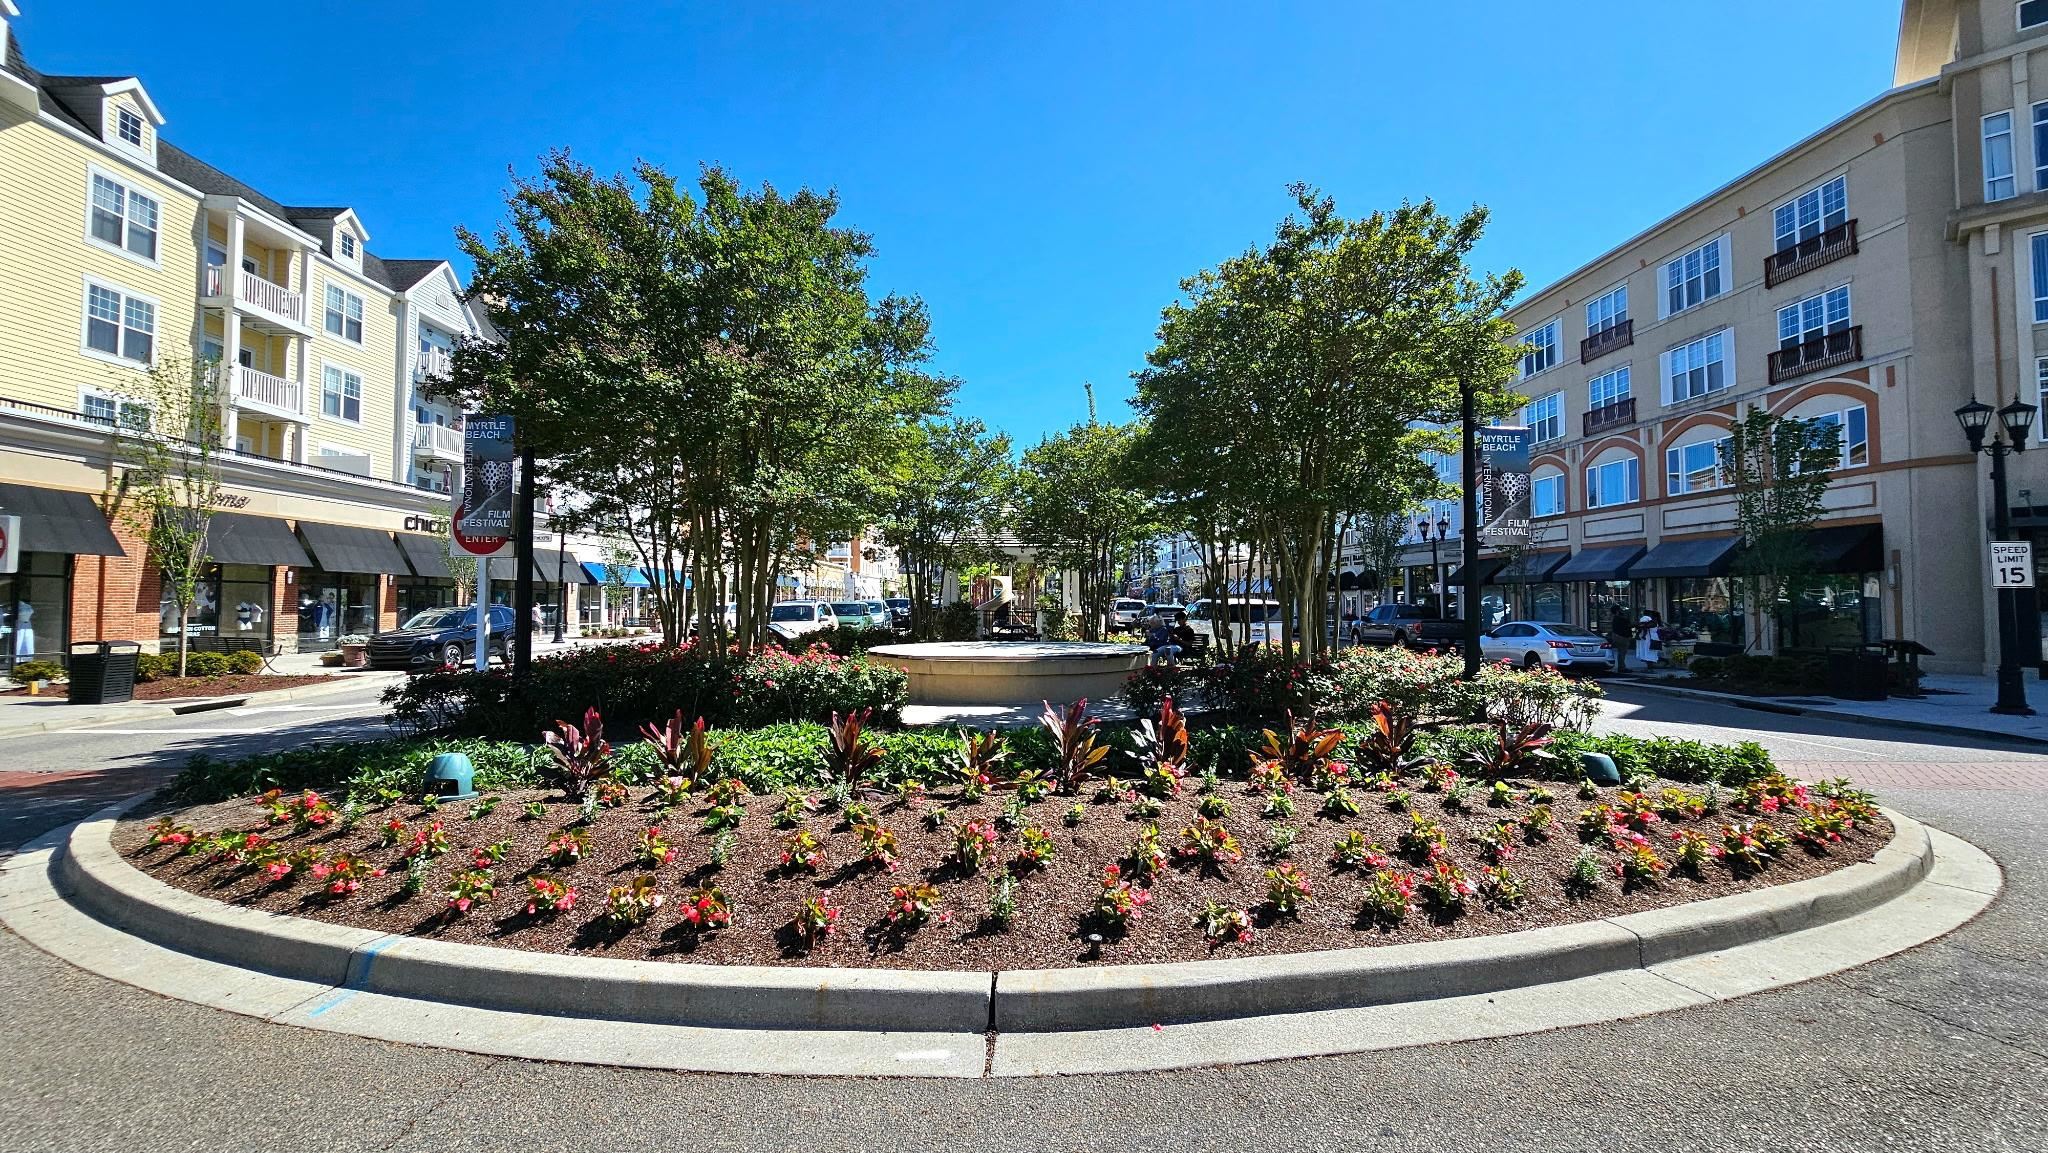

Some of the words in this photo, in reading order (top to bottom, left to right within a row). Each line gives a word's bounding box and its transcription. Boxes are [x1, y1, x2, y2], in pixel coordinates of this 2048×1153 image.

[466, 421, 506, 430] MYRTLE
[465, 430, 500, 439] BEACH
[1482, 435, 1521, 443] MYRTLE
[1482, 443, 1516, 452] BEACH
[464, 442, 473, 514] INTERNATIONAL
[1483, 454, 1493, 524] INTERNATIONAL
[488, 510, 511, 519] FILM
[463, 519, 510, 528] FESTIVAL
[1507, 519, 1529, 528] FILM
[1485, 527, 1529, 536] FESTIVAL
[1993, 546, 2028, 554] SPEED
[1997, 555, 2025, 563] LIMIT
[2000, 567, 2026, 584] 15
